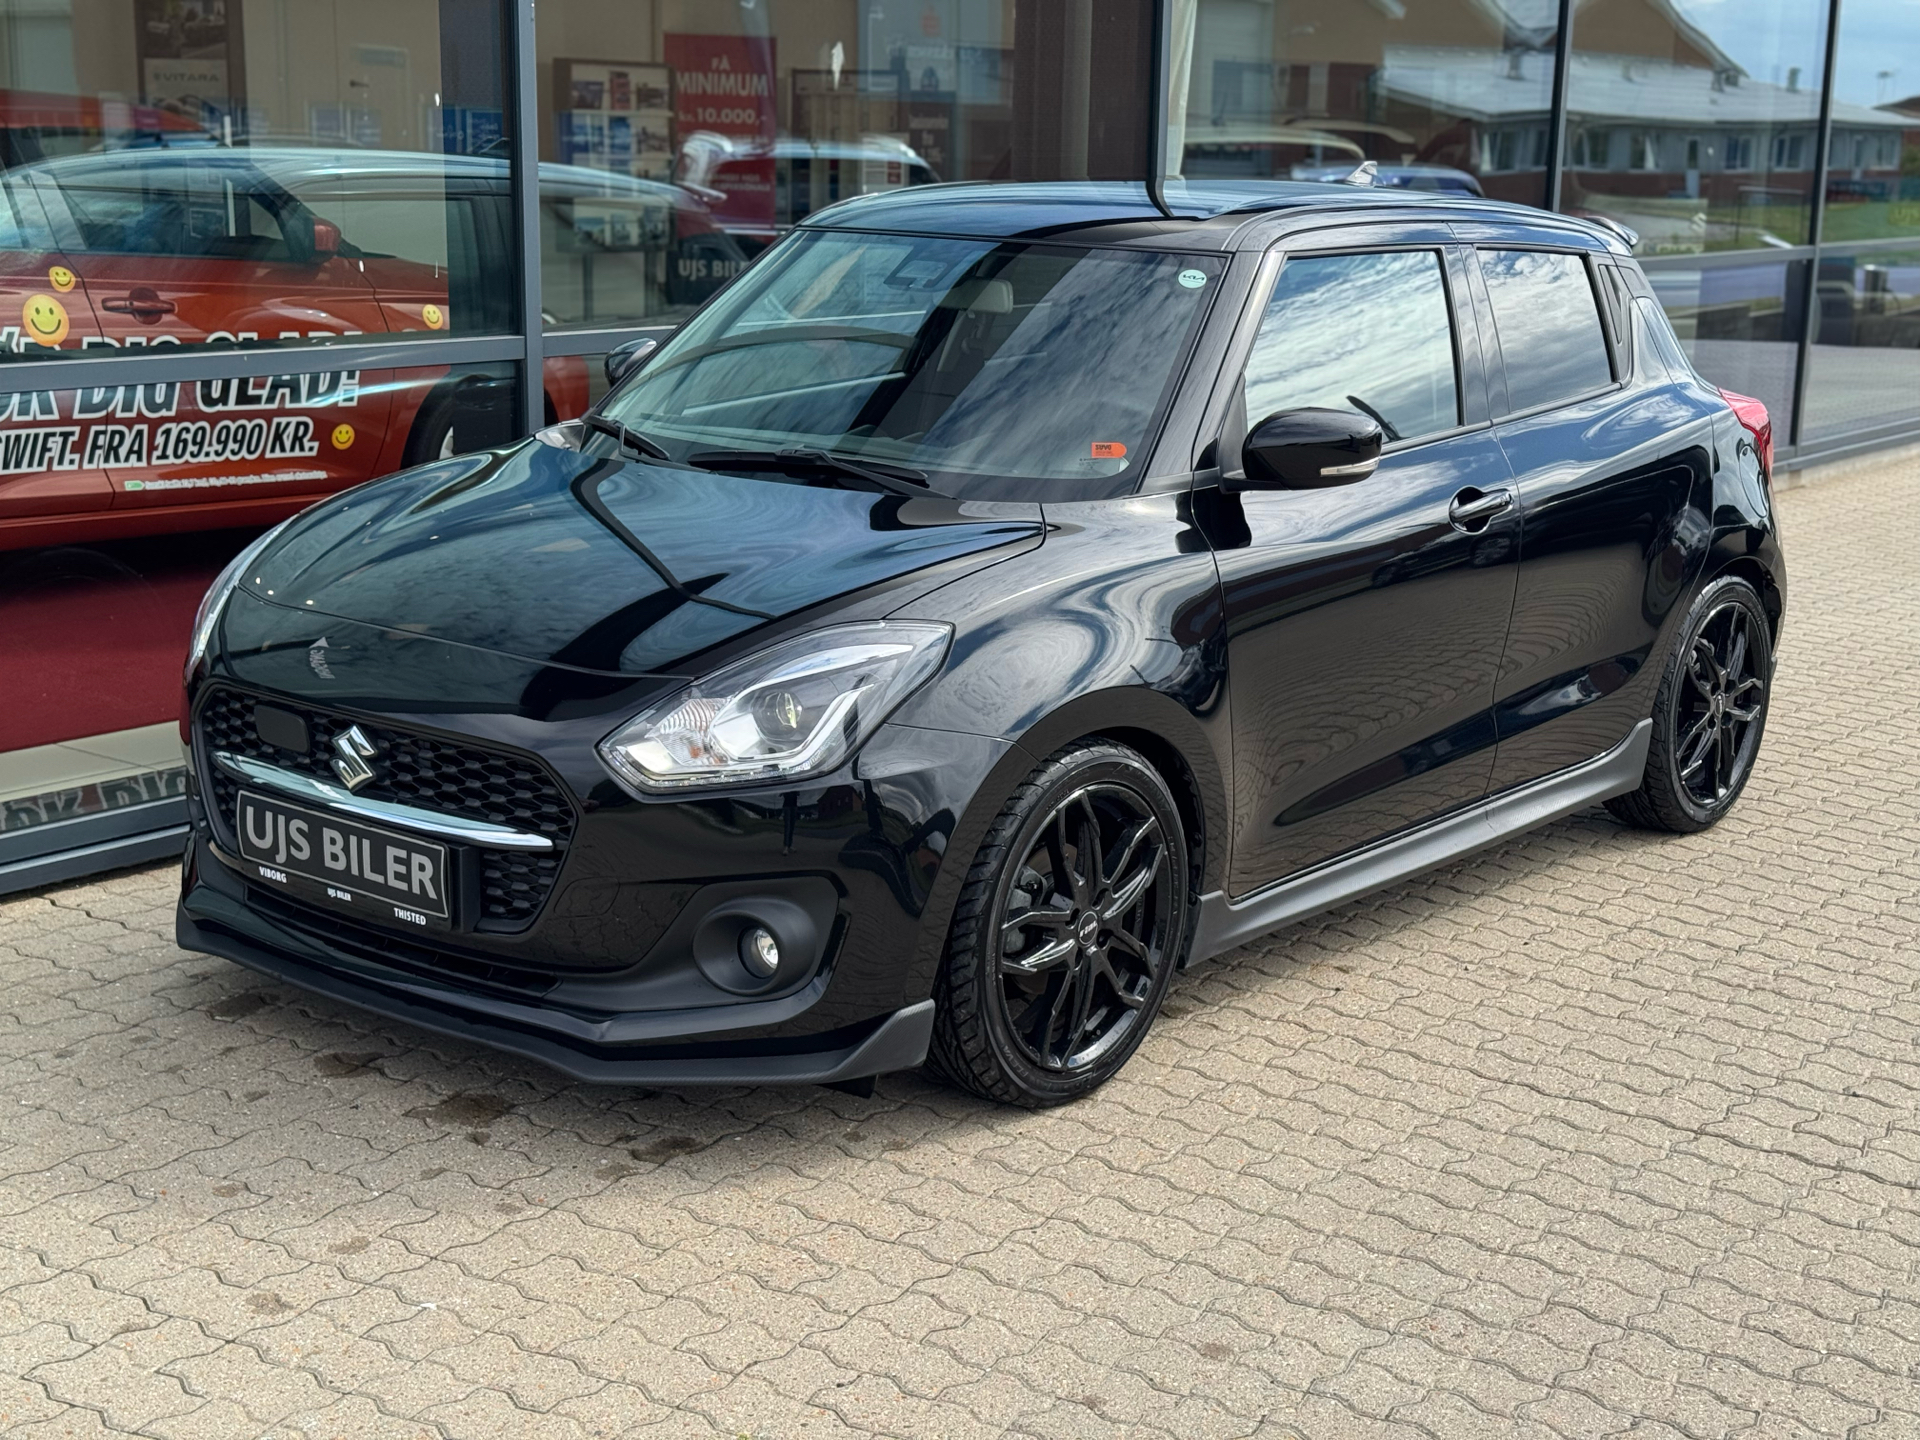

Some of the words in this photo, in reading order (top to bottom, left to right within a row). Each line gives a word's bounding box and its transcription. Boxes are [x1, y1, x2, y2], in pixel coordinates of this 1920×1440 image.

[676, 72, 769, 97] MINIMUM
[678, 258, 708, 281] UJS
[0, 426, 81, 475] WIFT.
[82, 424, 149, 469] FRA
[152, 419, 268, 466] 169.990
[265, 416, 320, 459] KR.
[246, 806, 311, 864] UJS
[323, 827, 438, 900] BILER
[258, 866, 287, 884] VIBORG
[326, 887, 337, 898] UJS
[336, 889, 352, 901] BILER
[393, 907, 427, 926] THISTED
